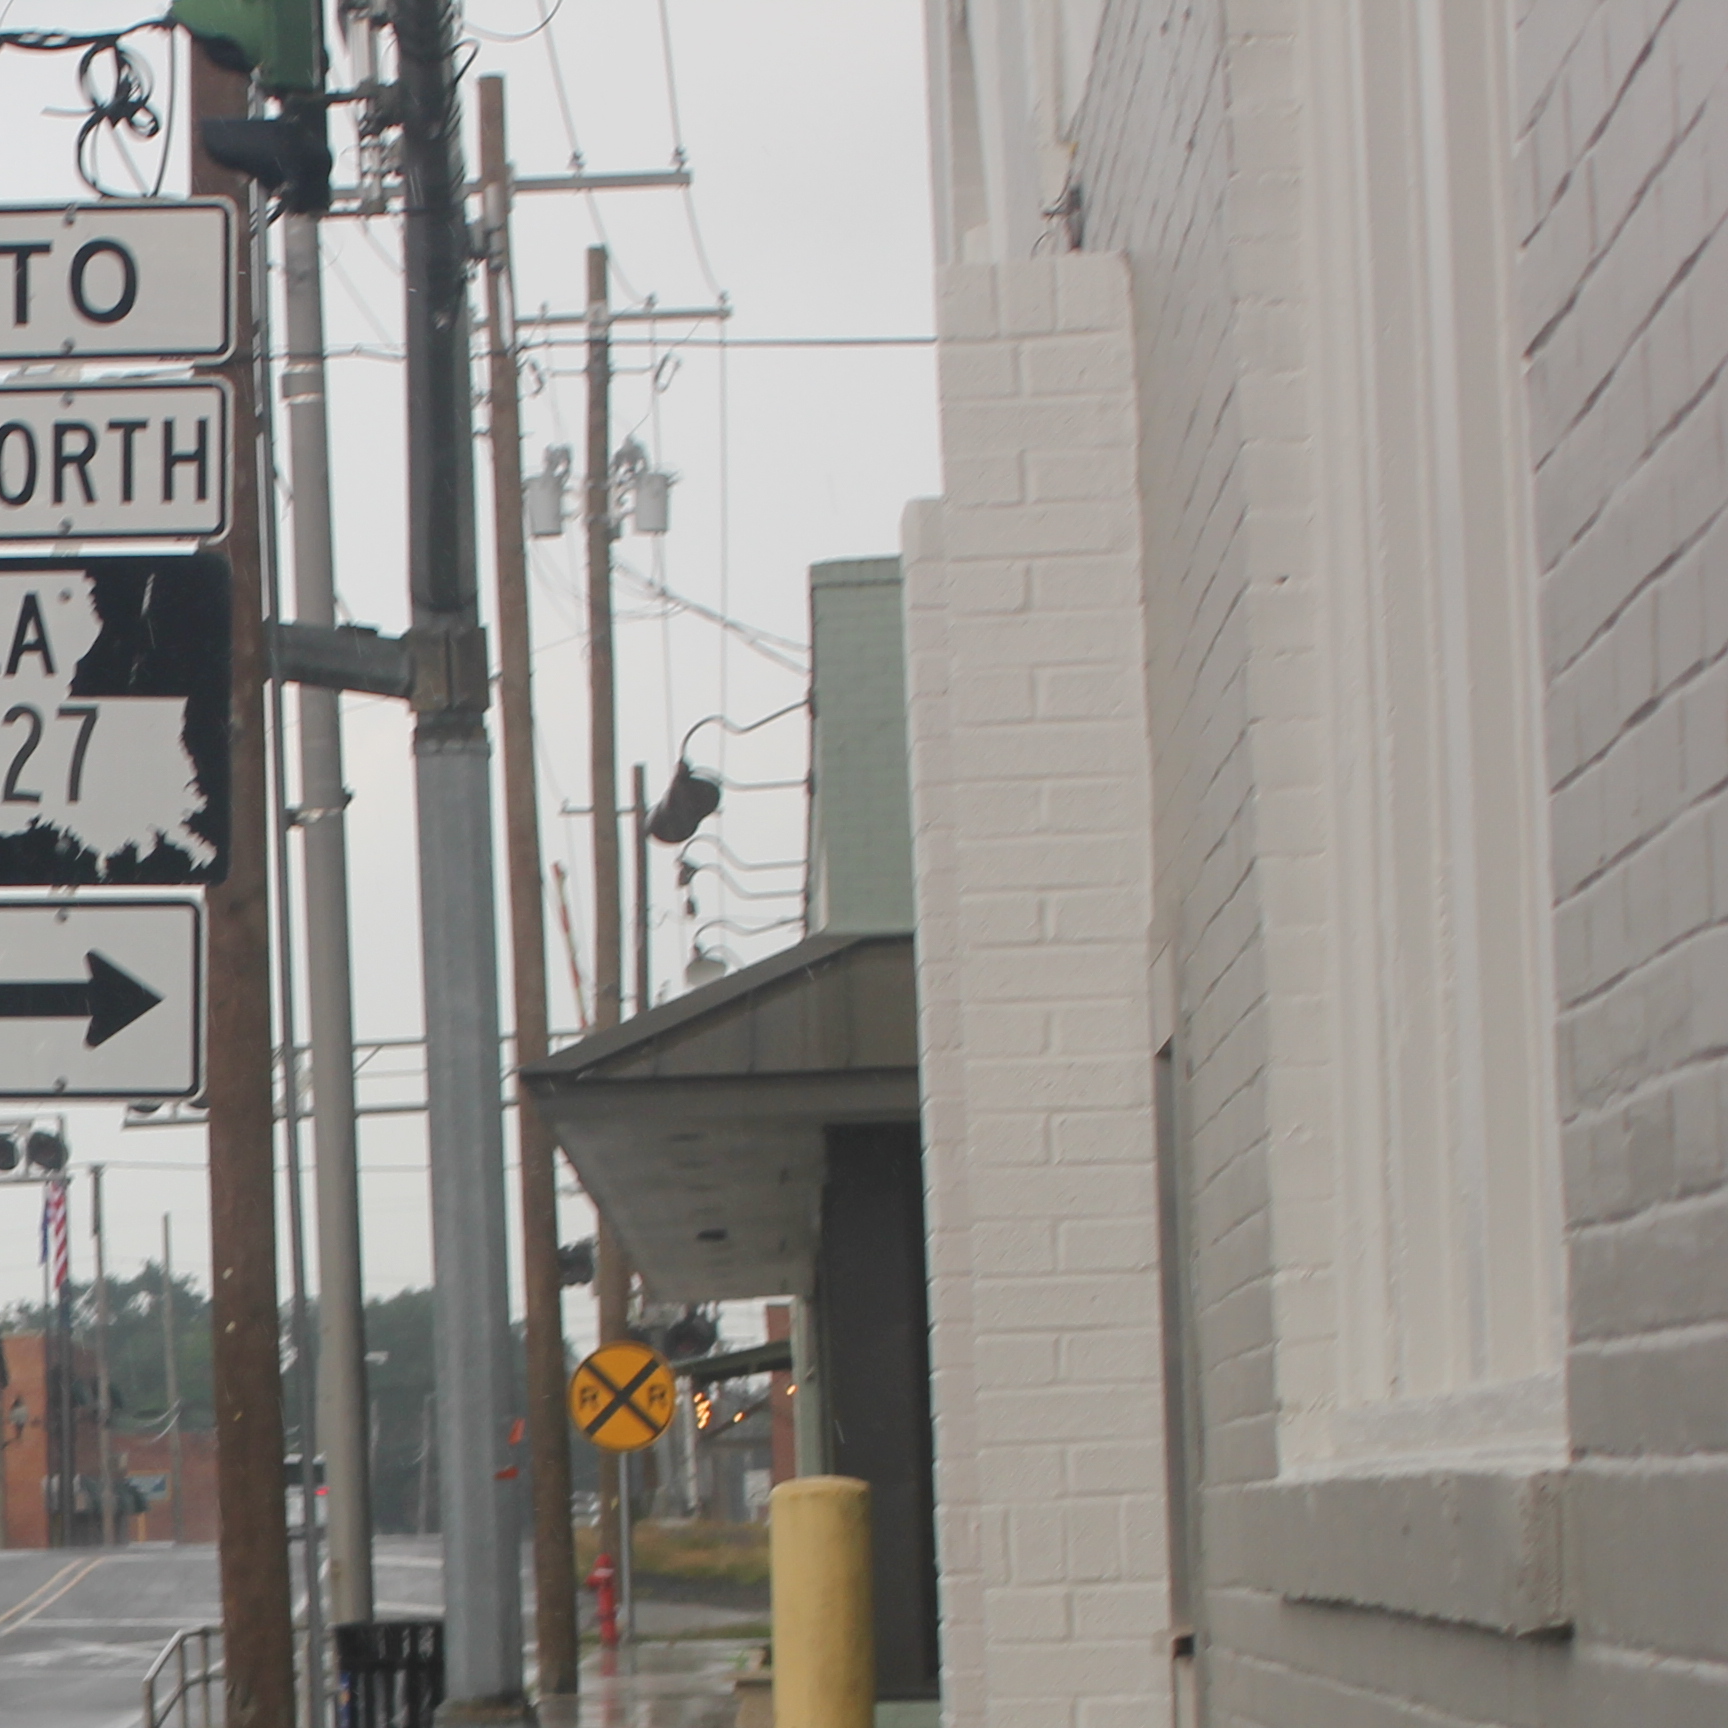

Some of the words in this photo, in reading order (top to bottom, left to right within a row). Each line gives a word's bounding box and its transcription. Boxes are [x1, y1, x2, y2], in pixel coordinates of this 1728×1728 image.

[1, 701, 101, 805] 27
[579, 1385, 599, 1412] R
[647, 1383, 667, 1411] R
